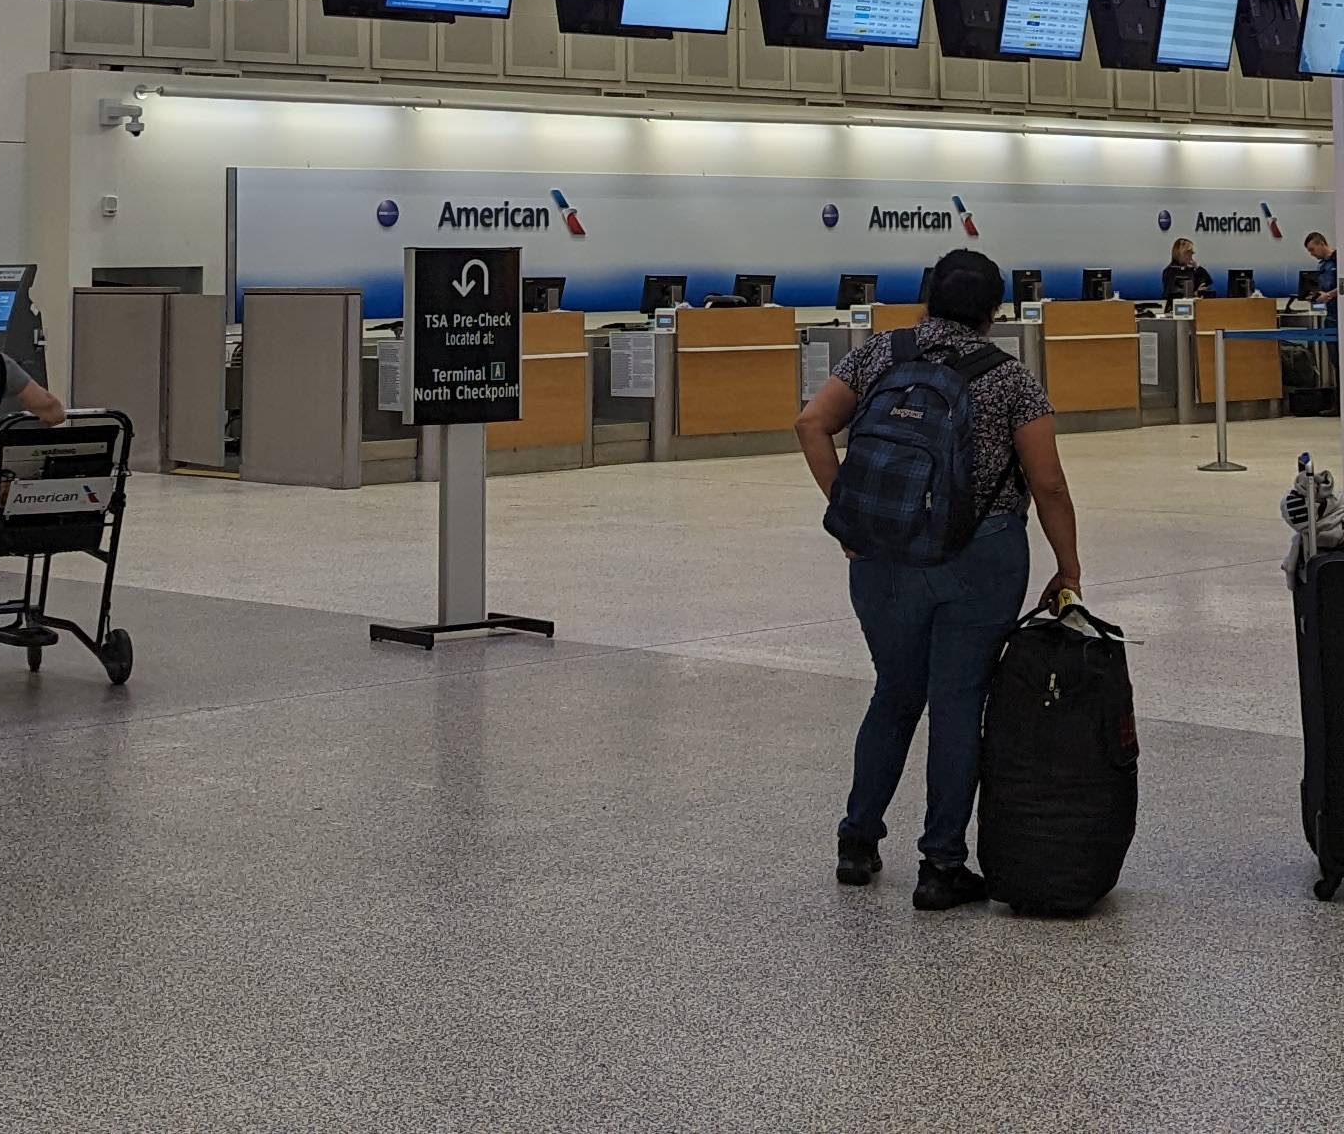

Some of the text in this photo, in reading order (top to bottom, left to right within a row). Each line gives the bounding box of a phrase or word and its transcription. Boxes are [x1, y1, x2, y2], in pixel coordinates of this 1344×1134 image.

[438, 201, 549, 228] American
[869, 205, 952, 231] American
[1195, 211, 1261, 234] American
[425, 312, 511, 328] TSA Pre-Check
[446, 331, 494, 346] Located at:
[432, 365, 501, 383] Terminal A
[414, 383, 519, 402] North Checkpoint
[13, 493, 78, 503] American
